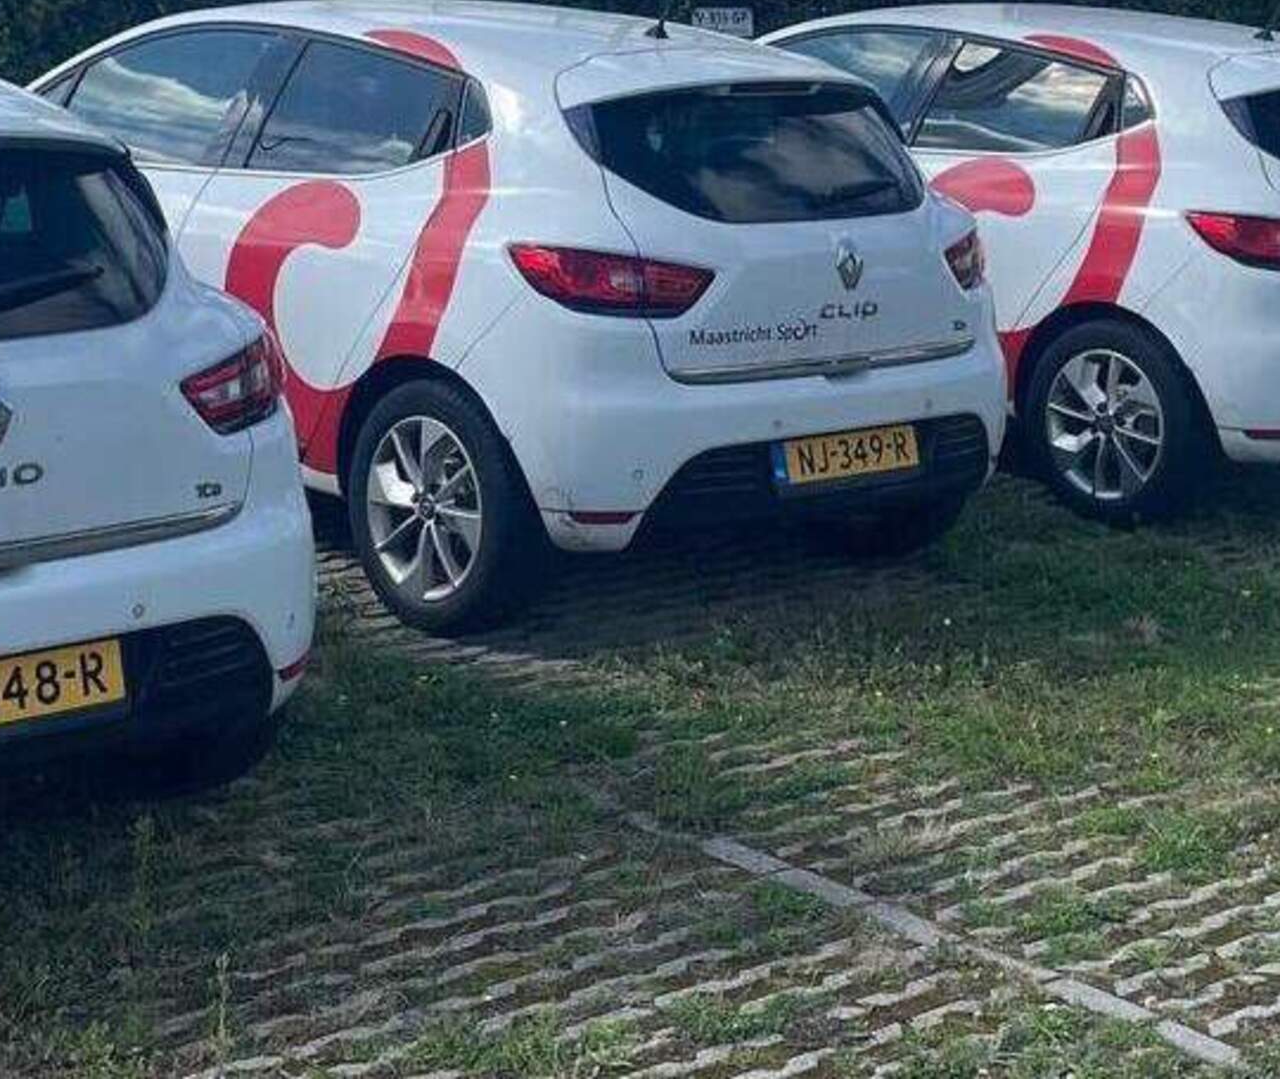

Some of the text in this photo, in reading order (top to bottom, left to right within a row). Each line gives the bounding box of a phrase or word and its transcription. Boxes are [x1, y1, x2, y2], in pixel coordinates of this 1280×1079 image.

[689, 319, 818, 345] Maastricht Sport
[797, 430, 911, 475] NJ-349-R
